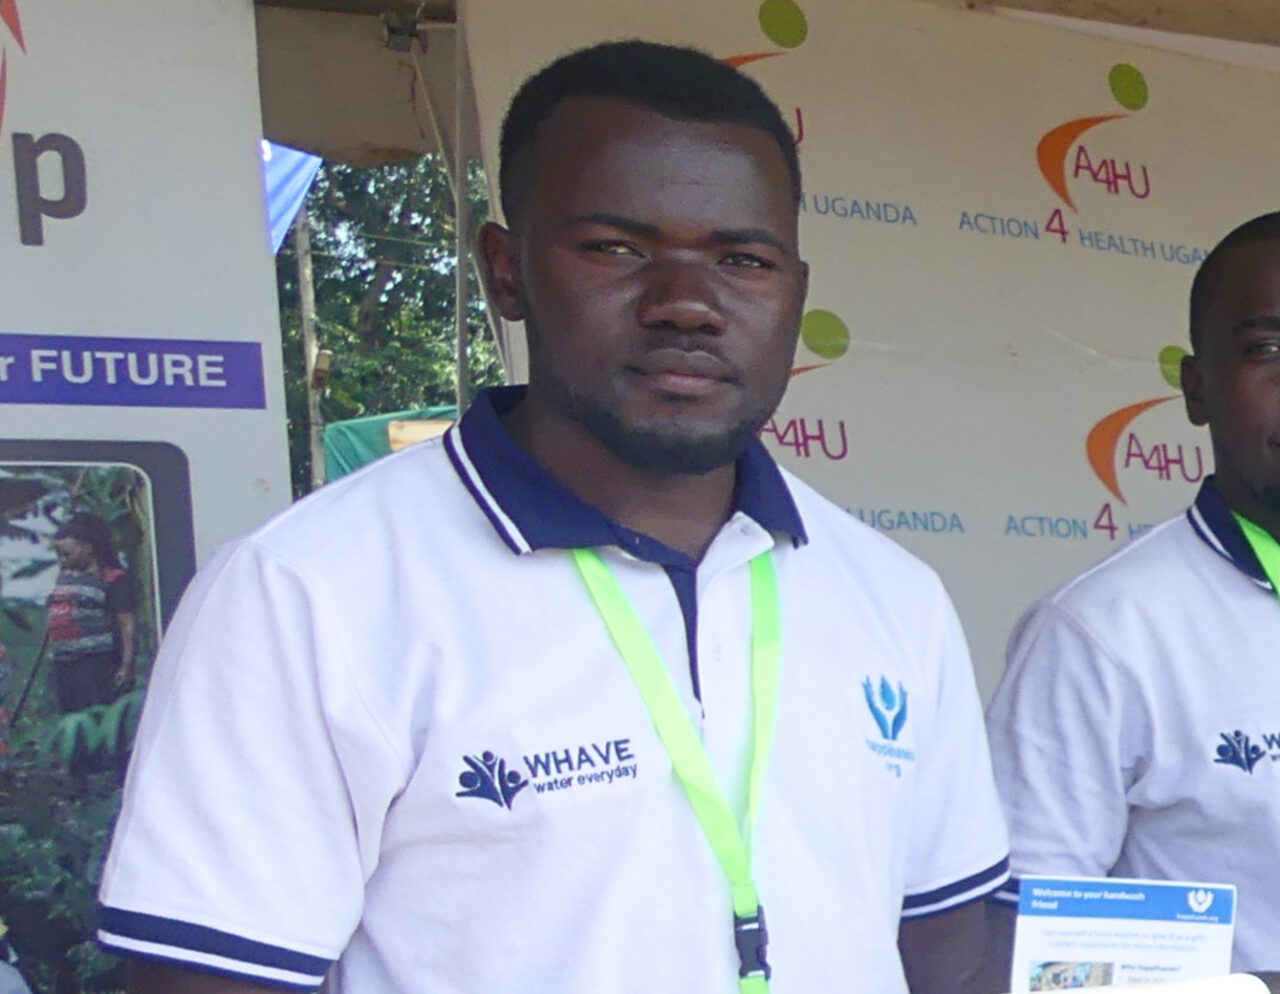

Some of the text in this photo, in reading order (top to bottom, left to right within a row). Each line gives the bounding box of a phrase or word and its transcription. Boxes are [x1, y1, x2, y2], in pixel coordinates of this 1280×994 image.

[1073, 145, 1150, 199] A4HU
[814, 195, 917, 226] UGANDA
[959, 208, 1211, 265] ACTION 4 HEALTH UGA
[31, 349, 227, 388] FUTURE
[1125, 433, 1203, 483] A4HU
[859, 509, 965, 534] UGANDA
[1005, 515, 1088, 539] ACTION
[1094, 503, 1118, 540] 4
[524, 738, 635, 778] WHAVE
[533, 764, 638, 794] water everyday
